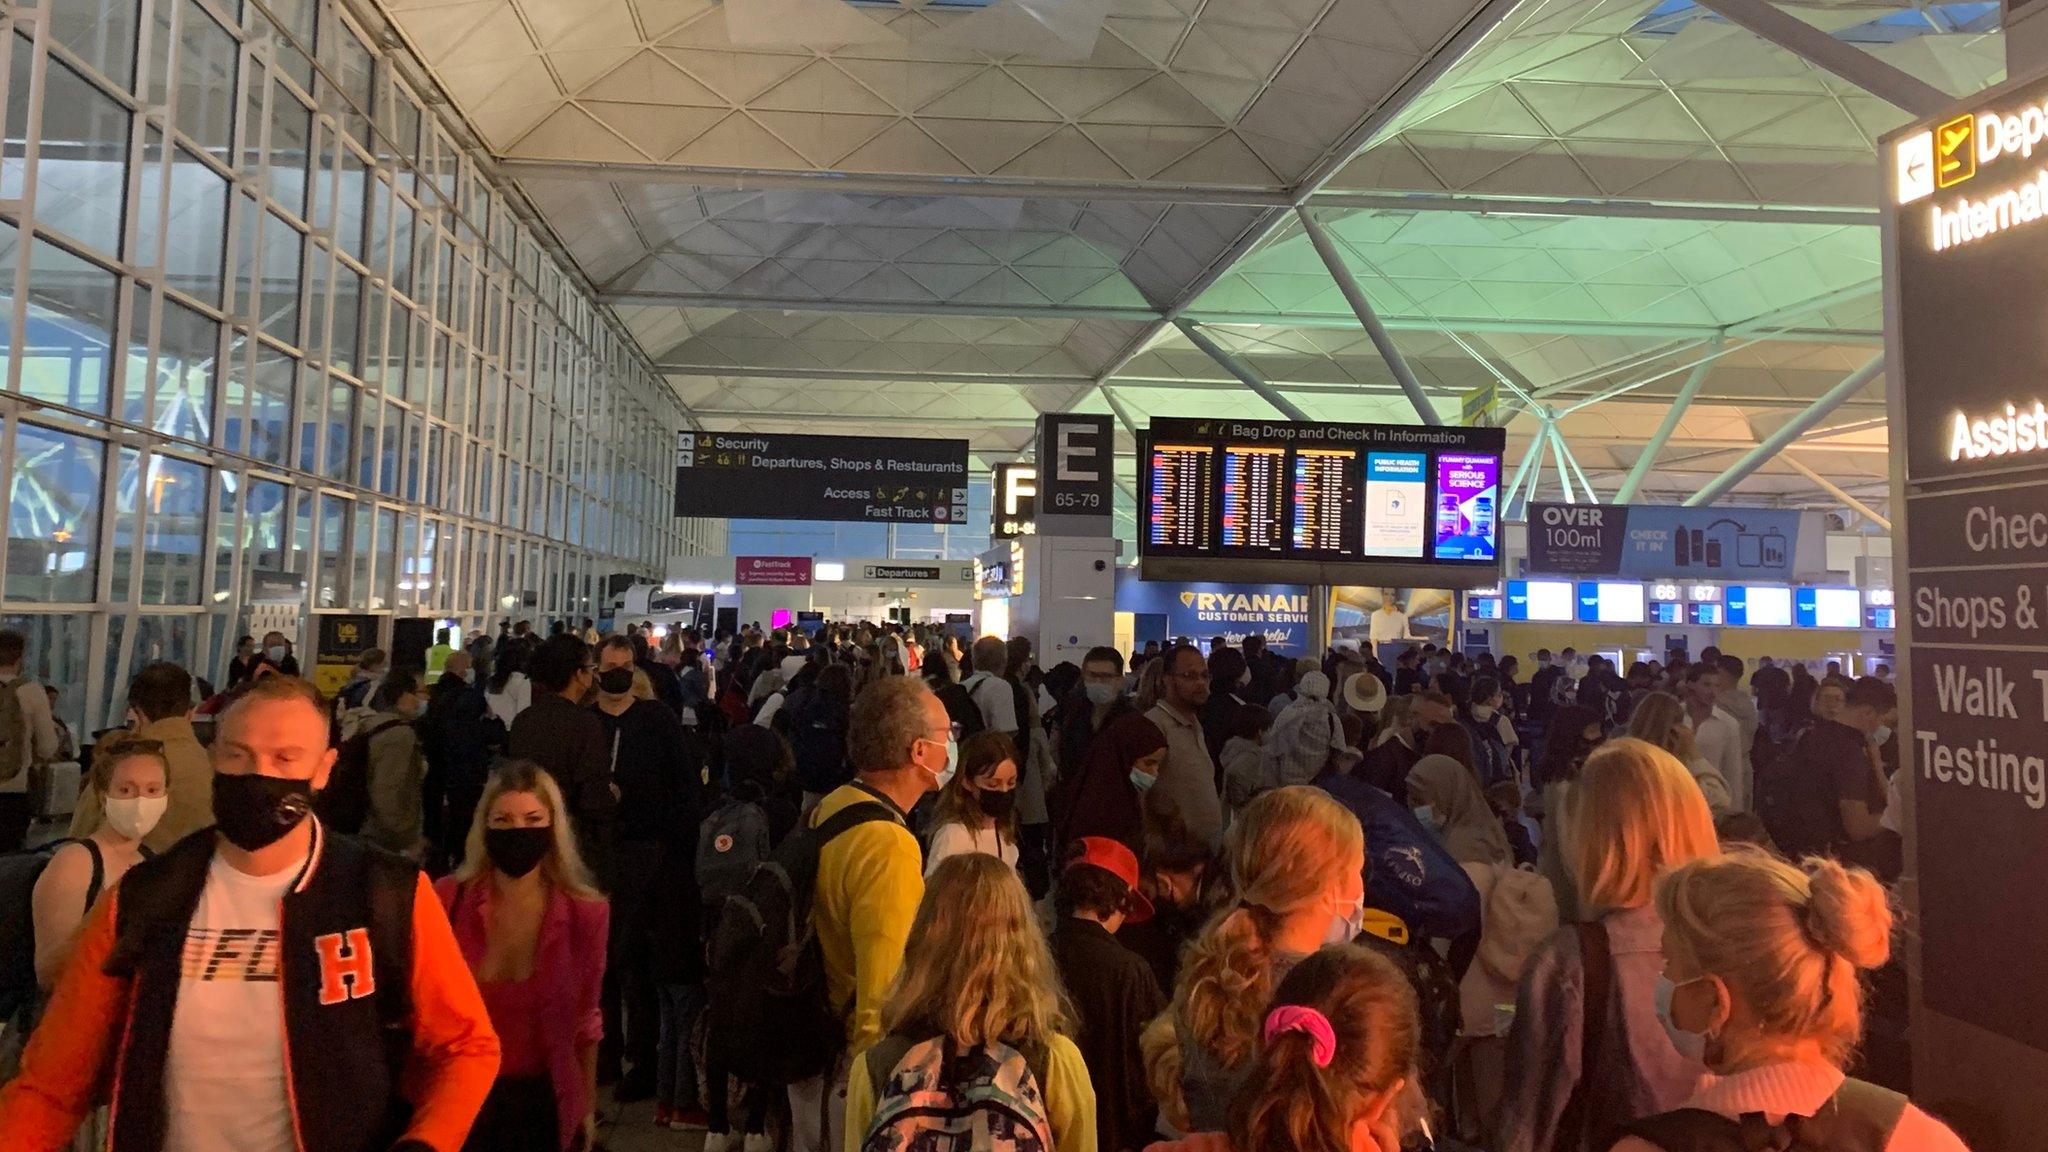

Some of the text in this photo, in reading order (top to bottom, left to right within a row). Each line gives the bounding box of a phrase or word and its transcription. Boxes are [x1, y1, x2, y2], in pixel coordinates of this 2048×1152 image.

[1977, 102, 2048, 163] Dep
[1232, 424, 1466, 444] Bag Drop and Check In Information
[715, 437, 770, 452] Security
[1057, 423, 1099, 481] E
[752, 455, 963, 474] Departures, Shops & Restaurants
[1374, 458, 1420, 467] PUBLIC HEALTH
[1374, 465, 1419, 473] INFORMATION
[1448, 471, 1485, 480] SERIOUS
[1448, 479, 1485, 488] SCIENCE
[823, 487, 871, 500] Access
[1005, 469, 1037, 515] F
[1055, 493, 1100, 507] 65-79
[866, 505, 929, 518] Fast Track
[1543, 507, 1603, 527] OVER
[1545, 528, 1601, 548] 100ml
[1630, 530, 1668, 541] CHECK
[1636, 542, 1664, 552] IT IN
[877, 567, 928, 580] Departures
[1655, 585, 1676, 600] 66
[1694, 585, 1715, 601] 67
[1198, 612, 1264, 622] CUSTOMER
[1916, 586, 2006, 639] Shops
[2015, 584, 2039, 630] &
[1933, 663, 2019, 720] Walk
[1916, 730, 2046, 809] Testing
[315, 928, 375, 1005] H
